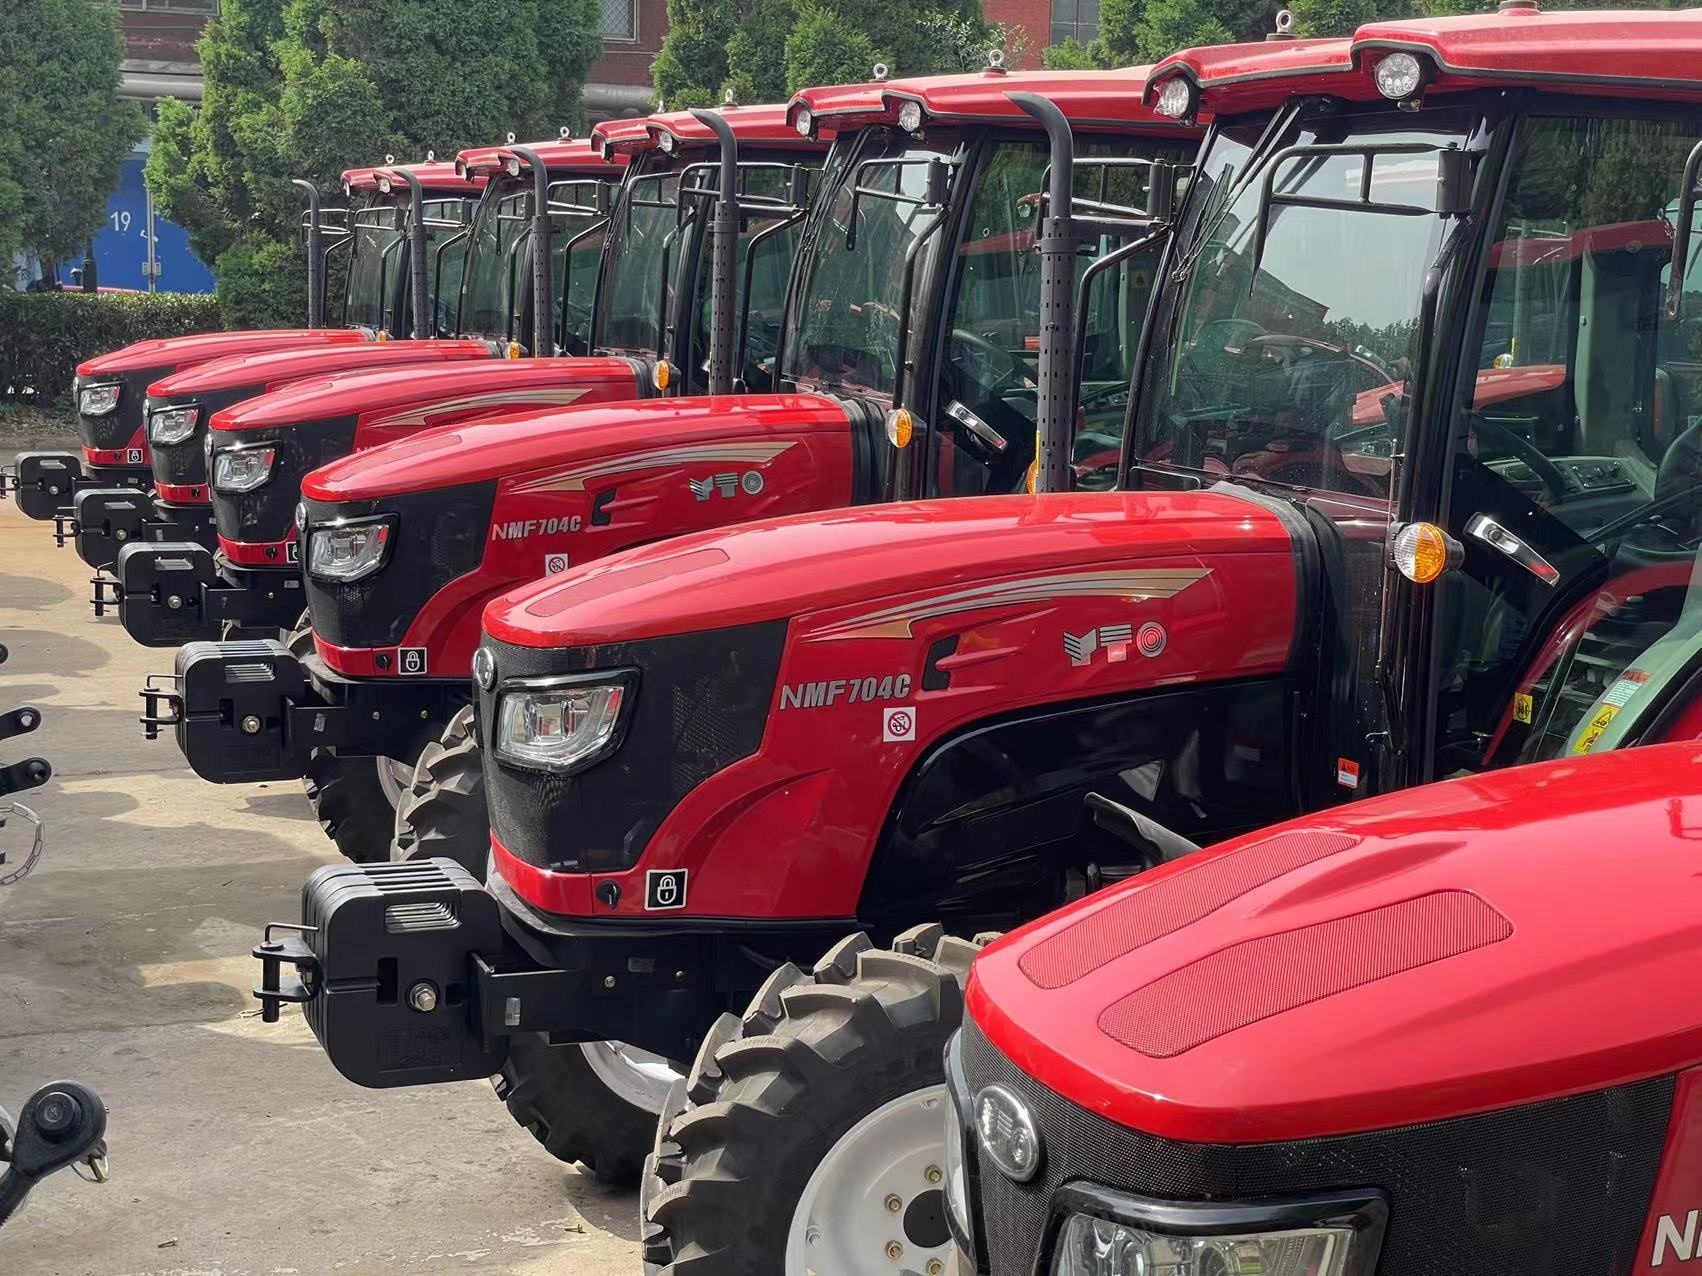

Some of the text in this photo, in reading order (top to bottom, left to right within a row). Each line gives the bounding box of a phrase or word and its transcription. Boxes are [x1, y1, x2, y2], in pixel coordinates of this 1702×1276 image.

[110, 211, 131, 231] 19
[1063, 621, 1167, 667] YTO
[1651, 1209, 1702, 1267] N
